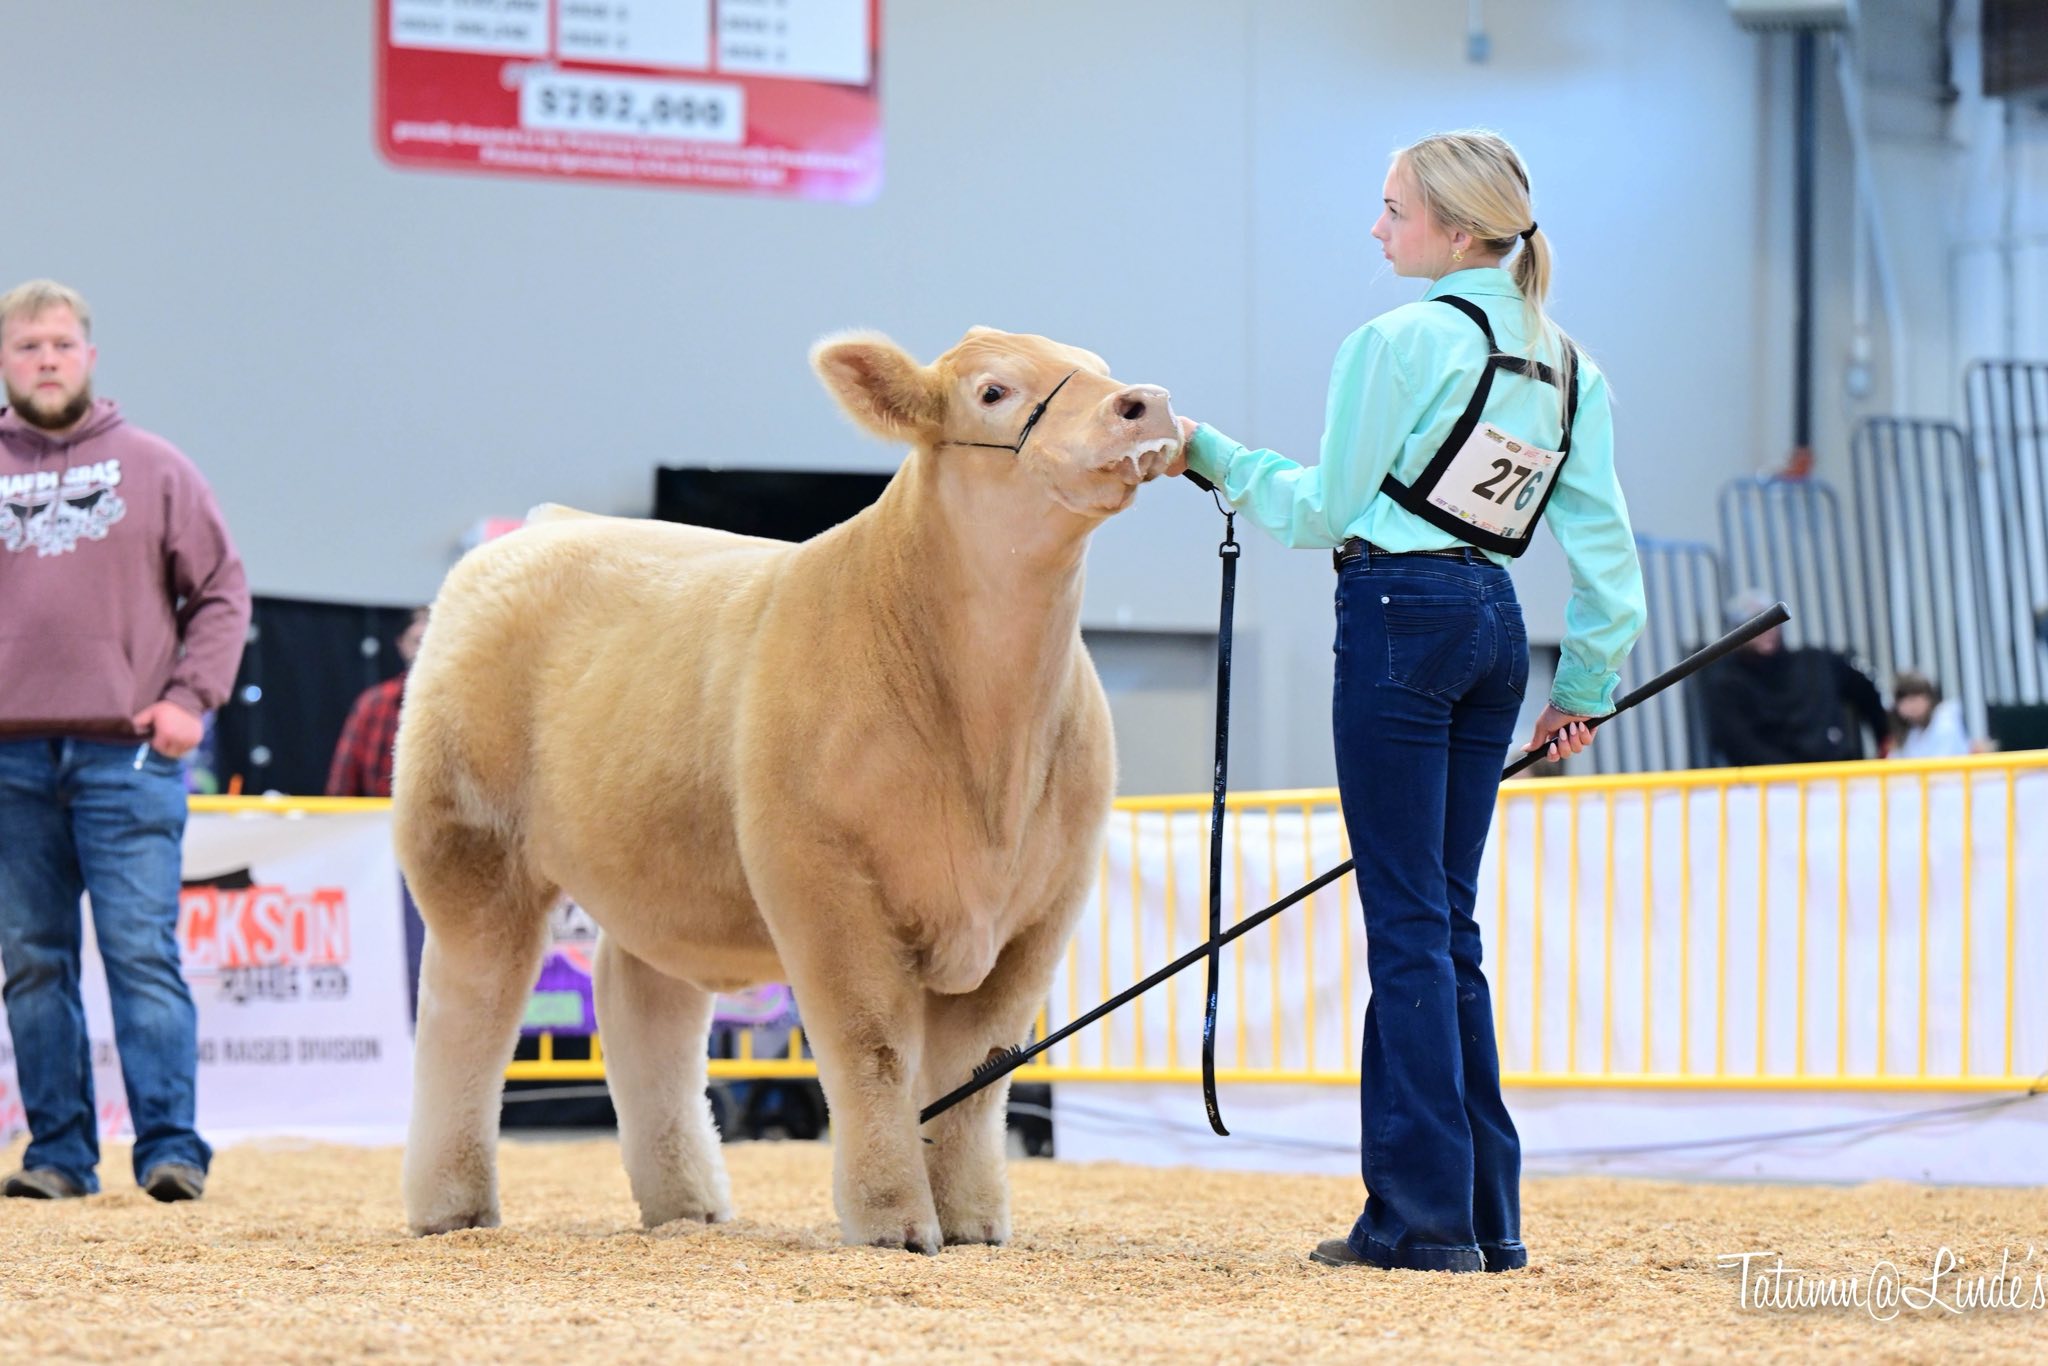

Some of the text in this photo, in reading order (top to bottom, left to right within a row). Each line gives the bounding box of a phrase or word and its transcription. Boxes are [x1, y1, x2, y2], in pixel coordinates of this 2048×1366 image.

[1471, 457, 1544, 511] 276
[179, 886, 349, 967] CKSON
[297, 1035, 380, 1065] DIVISION
